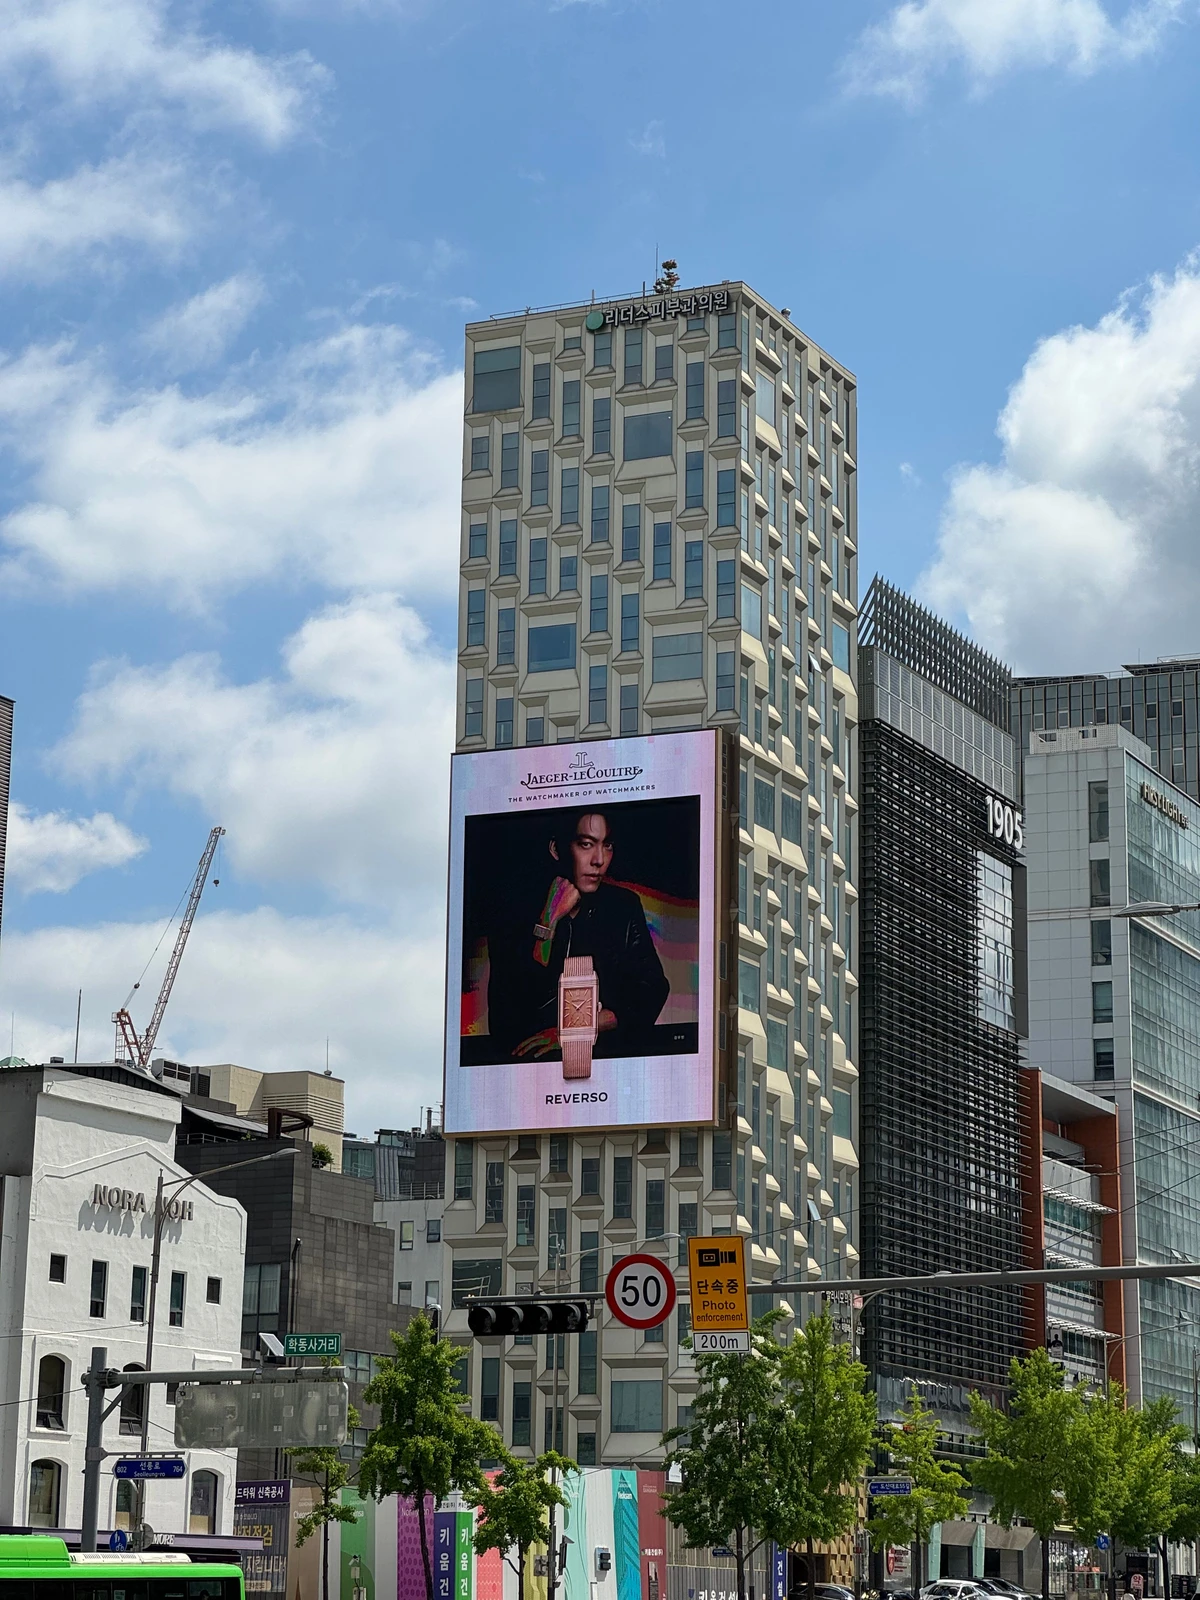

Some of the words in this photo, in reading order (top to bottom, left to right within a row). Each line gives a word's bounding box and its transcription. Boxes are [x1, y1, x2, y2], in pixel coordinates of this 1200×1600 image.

[605, 290, 728, 327] 리더스피부과의원
[525, 791, 580, 802] WATCHMAKER
[582, 789, 593, 797] OF
[595, 784, 656, 796] WATCHMAKERS
[985, 795, 1023, 850] 1905
[545, 1091, 608, 1105] REVERSO
[93, 1183, 147, 1212] NORA
[621, 1275, 661, 1307] 50
[697, 1279, 739, 1295] 단속중
[702, 1300, 736, 1310] Photo
[696, 1313, 743, 1322] enforcement
[288, 1337, 337, 1352] 학동사거리
[701, 1334, 739, 1349] 200m
[173, 1465, 183, 1473] 764
[258, 1485, 284, 1499] 신축공사
